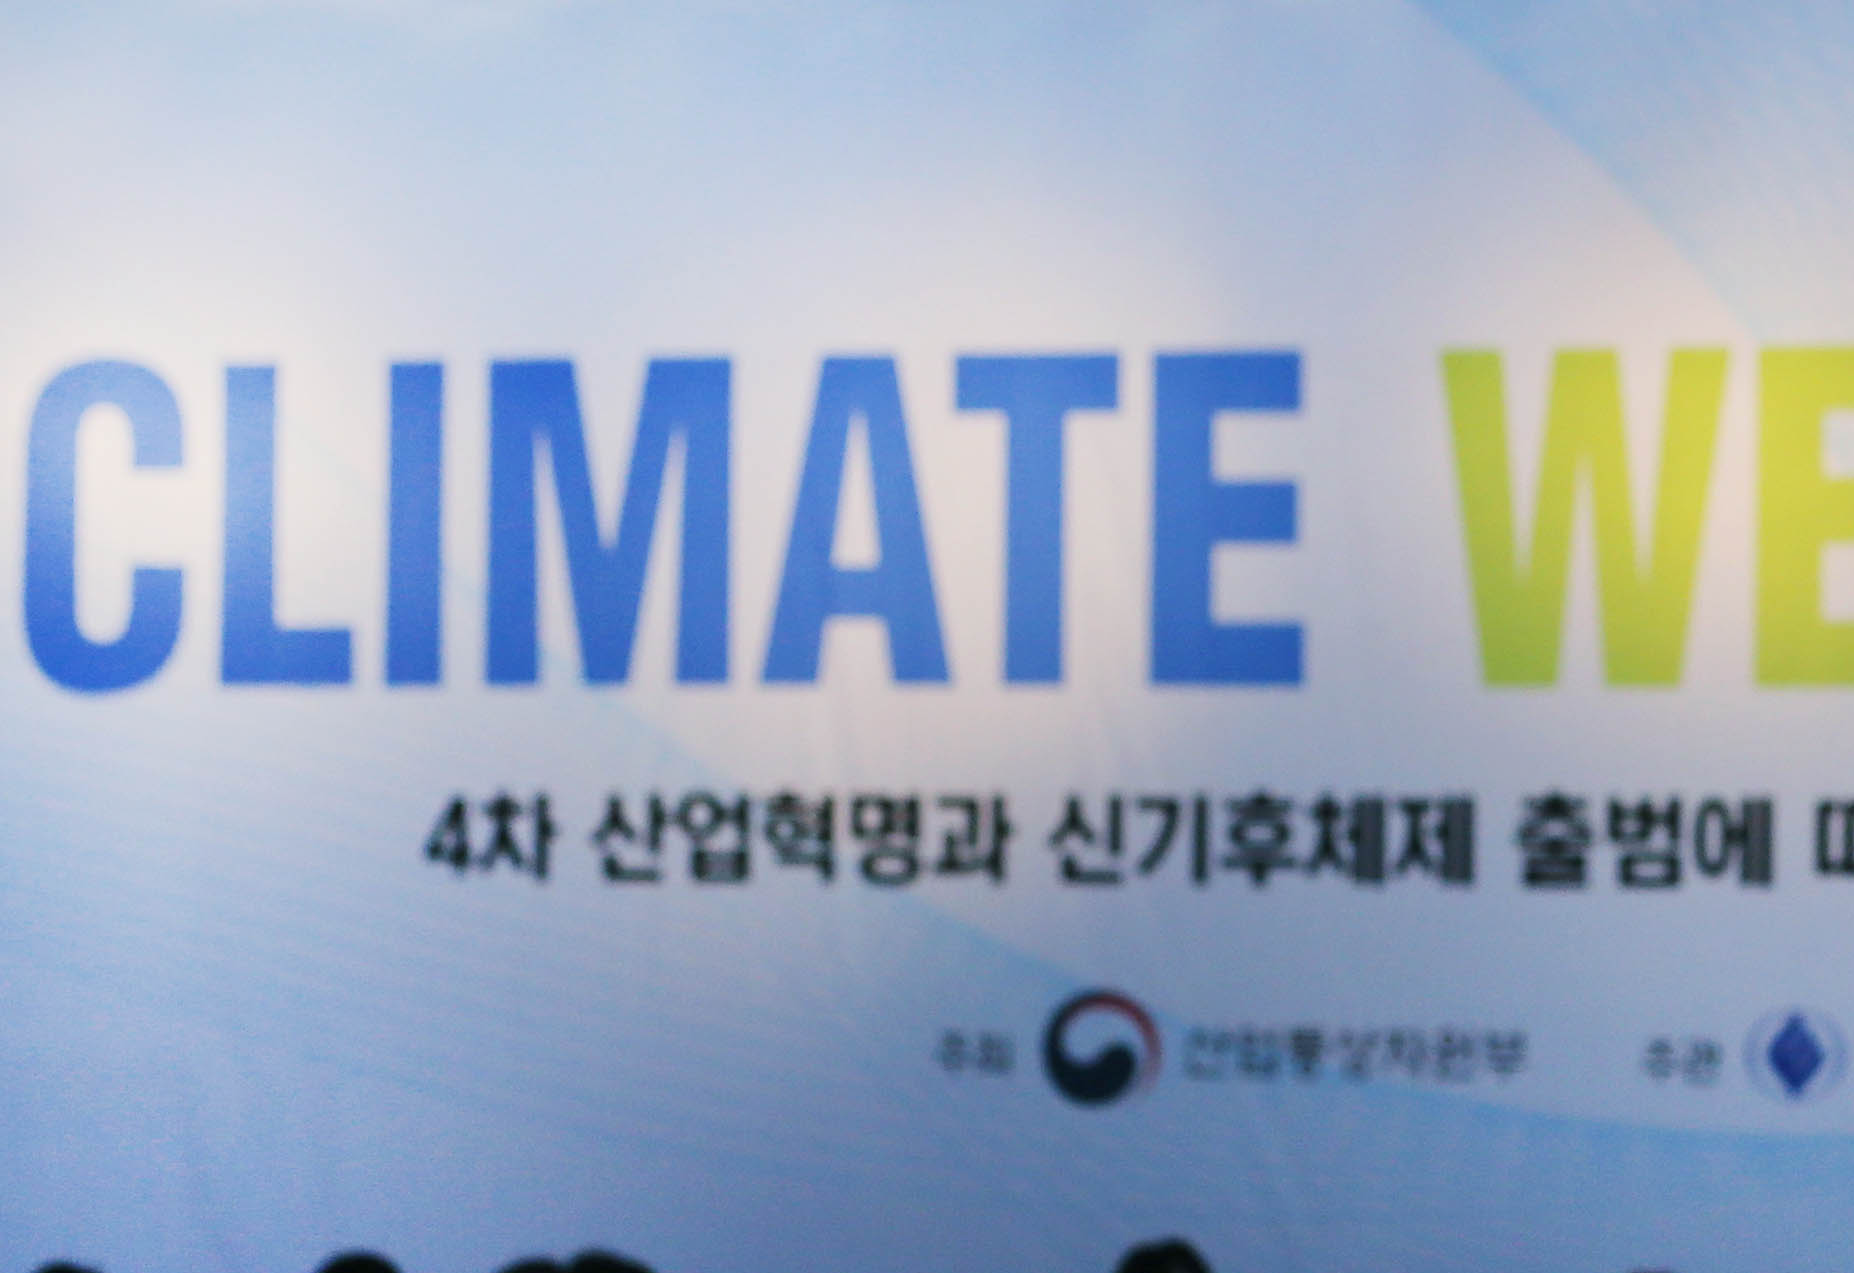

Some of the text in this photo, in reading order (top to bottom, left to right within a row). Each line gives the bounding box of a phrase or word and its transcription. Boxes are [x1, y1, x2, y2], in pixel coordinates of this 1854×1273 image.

[22, 349, 1306, 694] CLIMATE
[424, 793, 558, 882] 4차
[592, 791, 1017, 886] 산업혁명과
[1048, 793, 1478, 888] 신기후체제
[1514, 793, 1776, 888] 출범에
